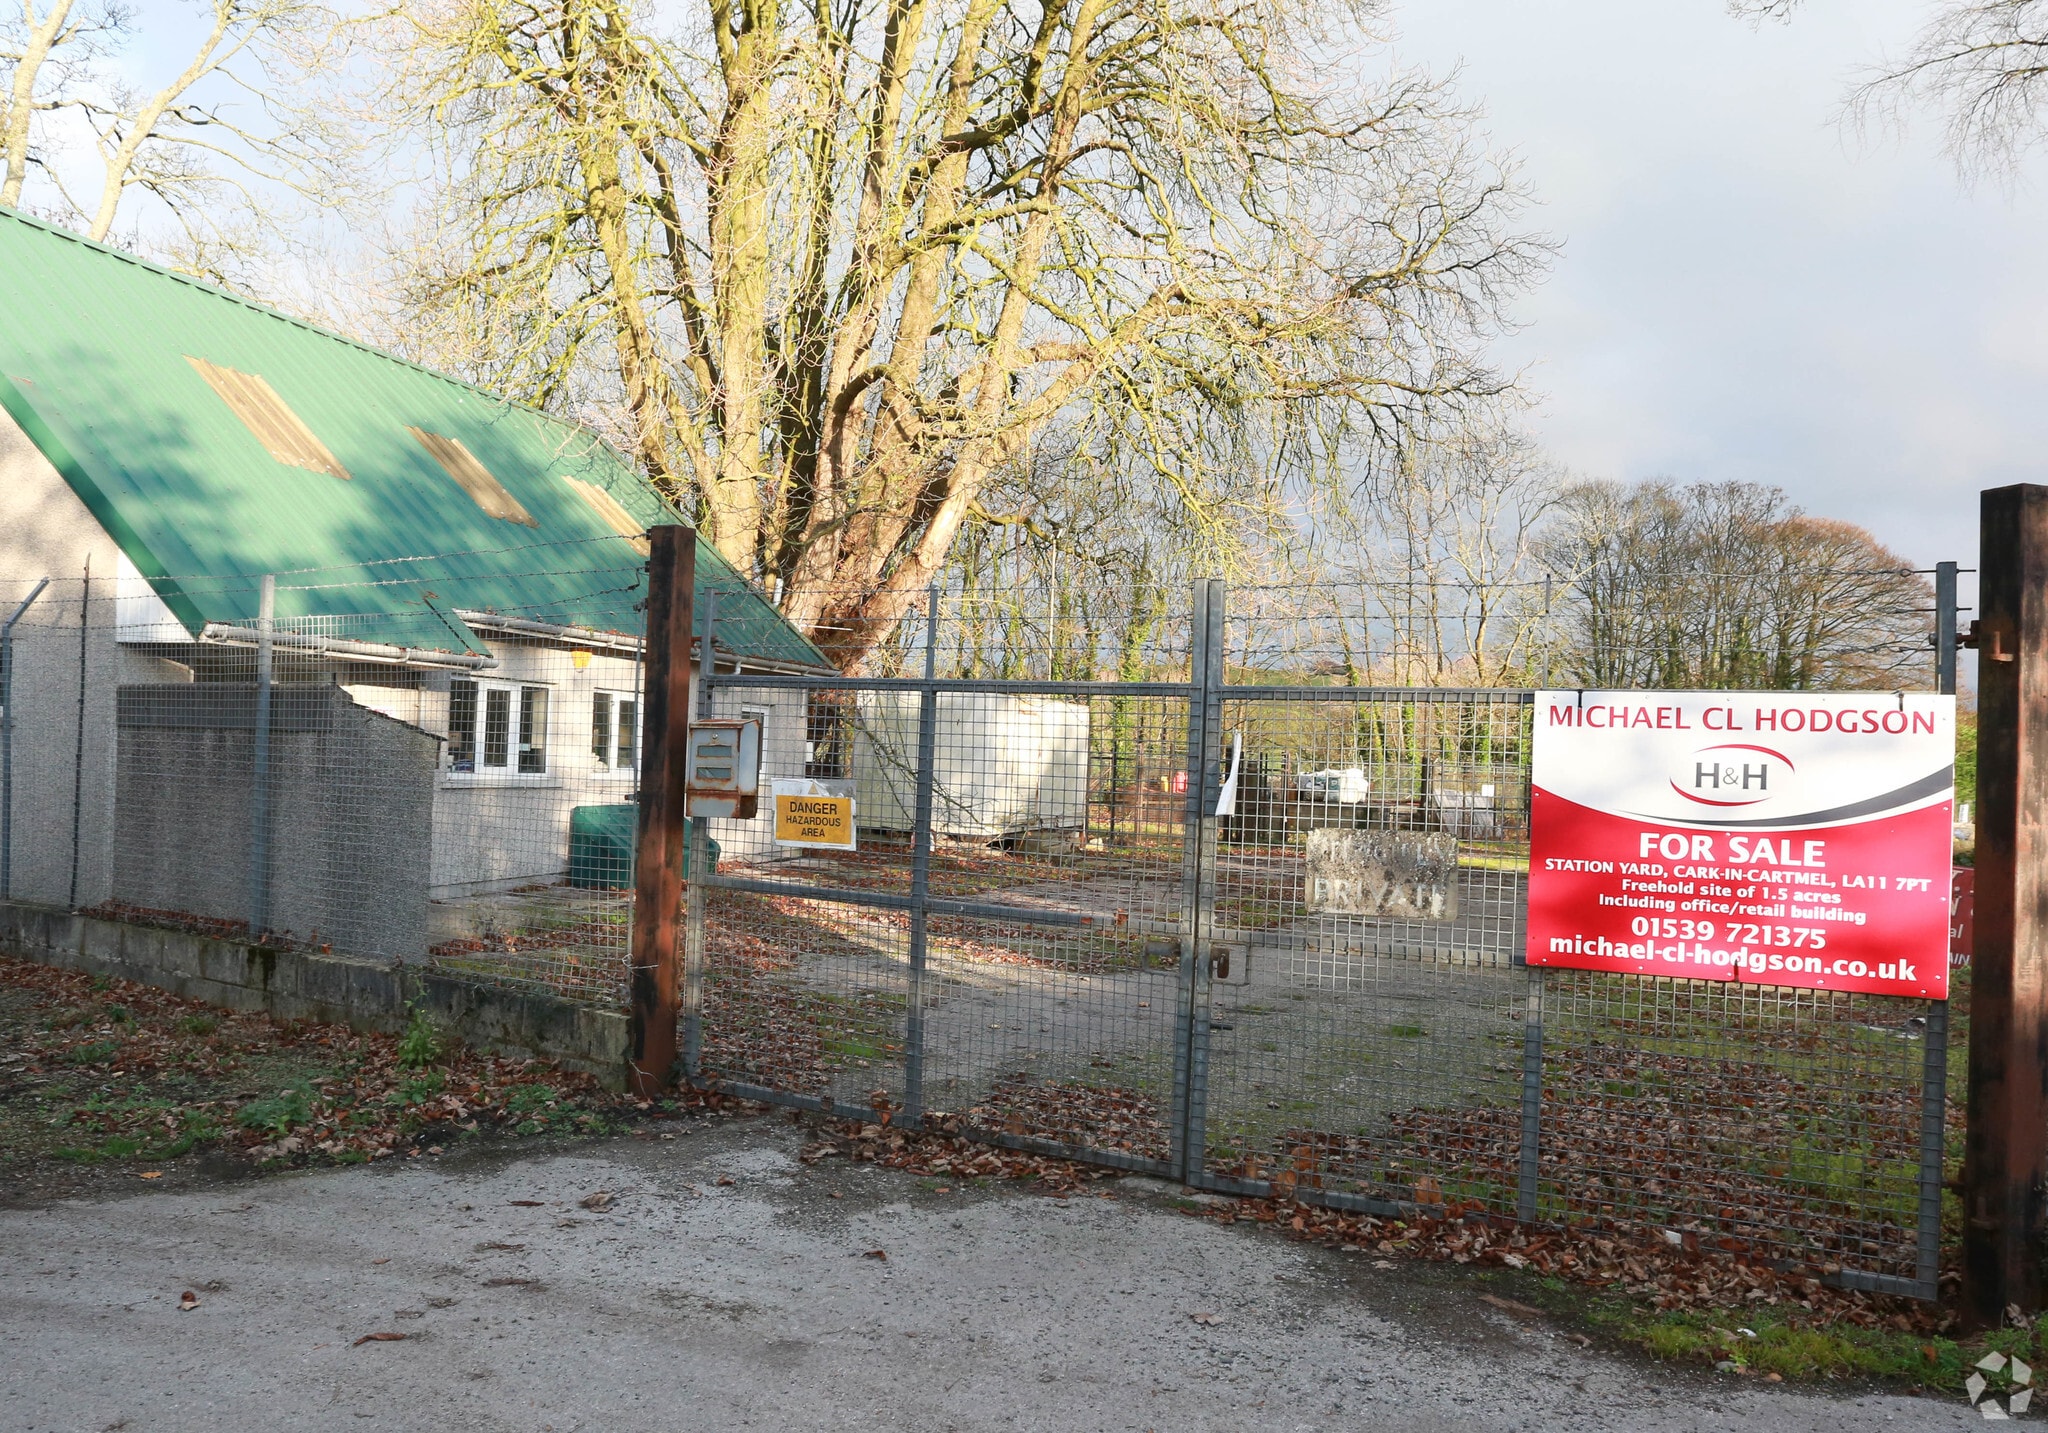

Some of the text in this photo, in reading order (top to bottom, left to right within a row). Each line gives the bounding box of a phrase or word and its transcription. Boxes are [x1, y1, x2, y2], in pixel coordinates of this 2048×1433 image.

[1549, 705, 1935, 735] MICHAEL CL HODGSON
[1694, 762, 1768, 790] H&H
[786, 815, 841, 827] HAZARDOUS
[789, 801, 837, 815] DANGER
[801, 827, 825, 838] AREA
[1639, 832, 1826, 867] FOR SALE
[1545, 858, 1932, 892] STATION YARD, CARK-IN-CARTMEL, LA11 7PT
[1622, 878, 1842, 904] Freehold site of 1.5 acres
[1598, 893, 1867, 925] Including office/retail building
[1631, 916, 1827, 949] 01539 721375
[1550, 934, 1917, 981] michael-cl-hodgson.co.uk
